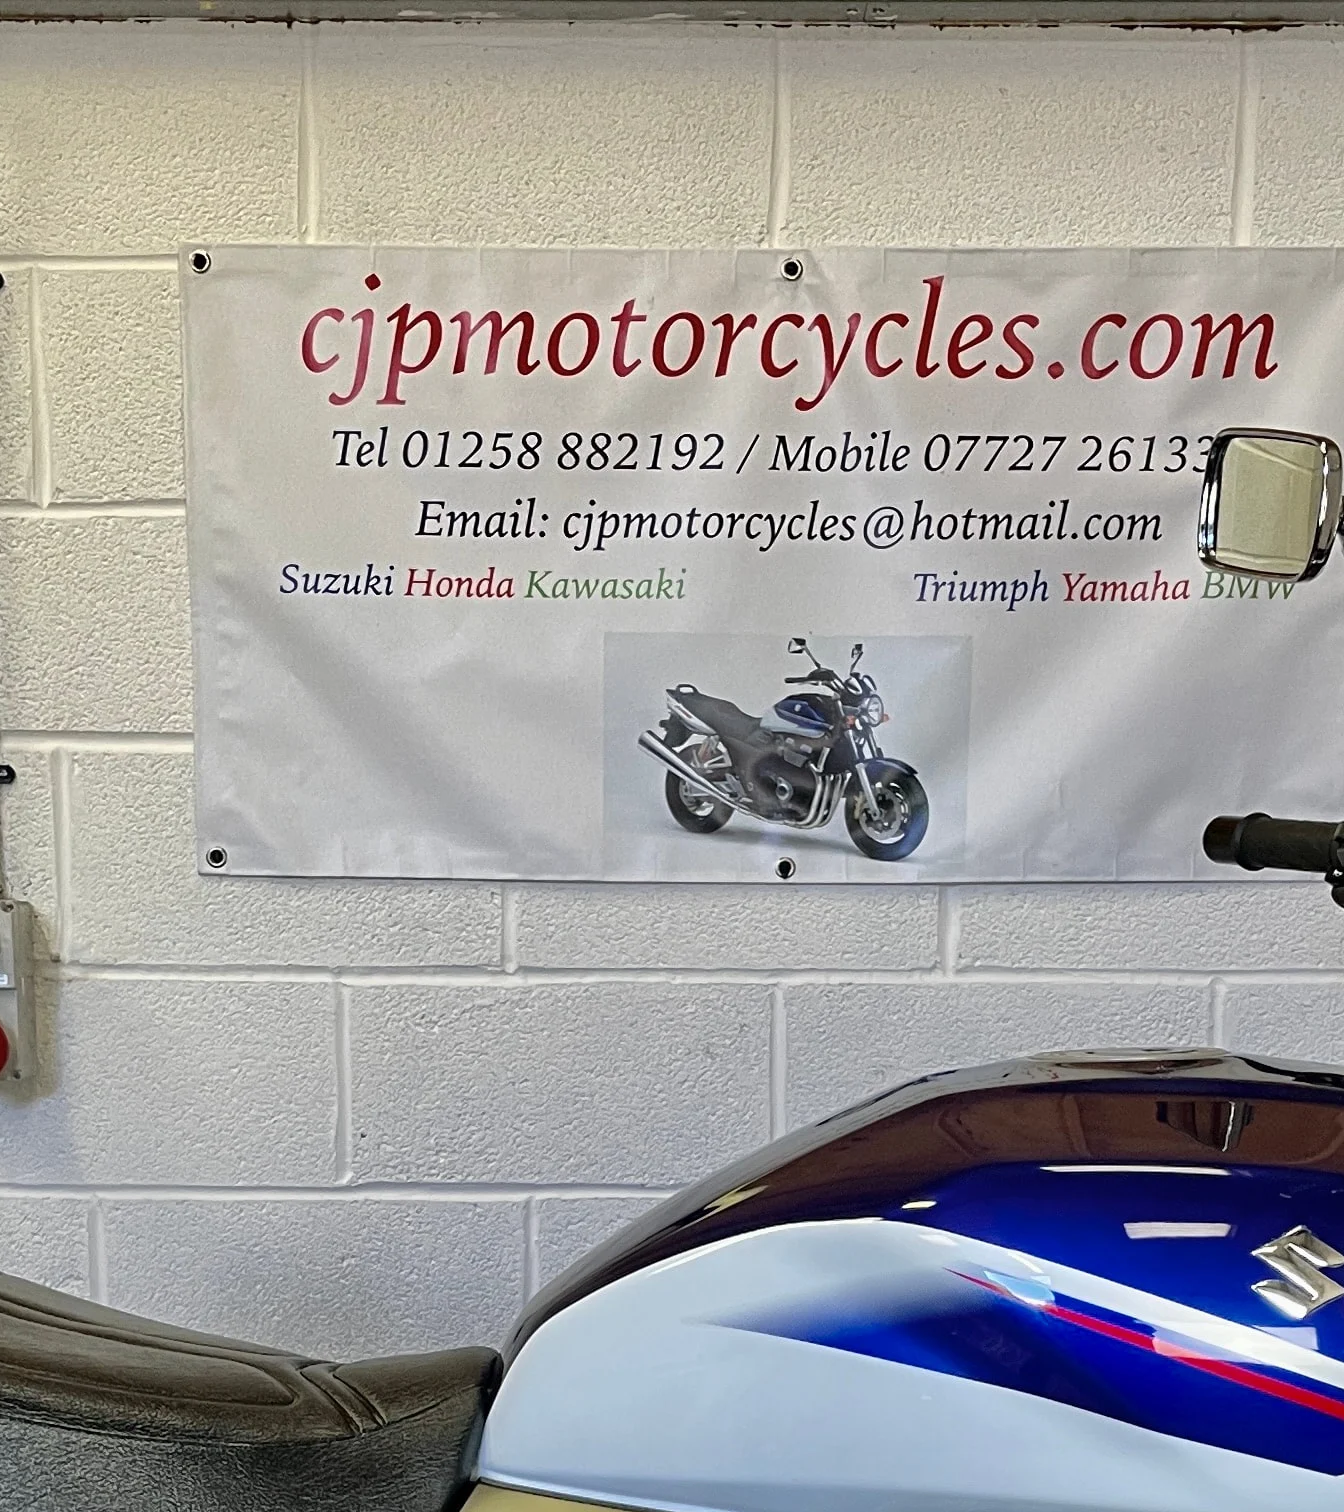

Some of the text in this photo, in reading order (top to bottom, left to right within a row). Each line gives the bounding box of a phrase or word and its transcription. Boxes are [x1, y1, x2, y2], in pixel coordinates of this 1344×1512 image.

[300, 274, 1278, 411] cjpmotorcycles.com
[332, 426, 1214, 474] Tel 01258 882192 / Mobile 07727 26133
[414, 498, 1163, 552] Email: cjpmotorcycles@hotmail.com
[279, 563, 687, 600] Suzuki Honda Kawasaki
[913, 569, 1050, 612] Triumph
[1061, 569, 1191, 601] Yamaha
